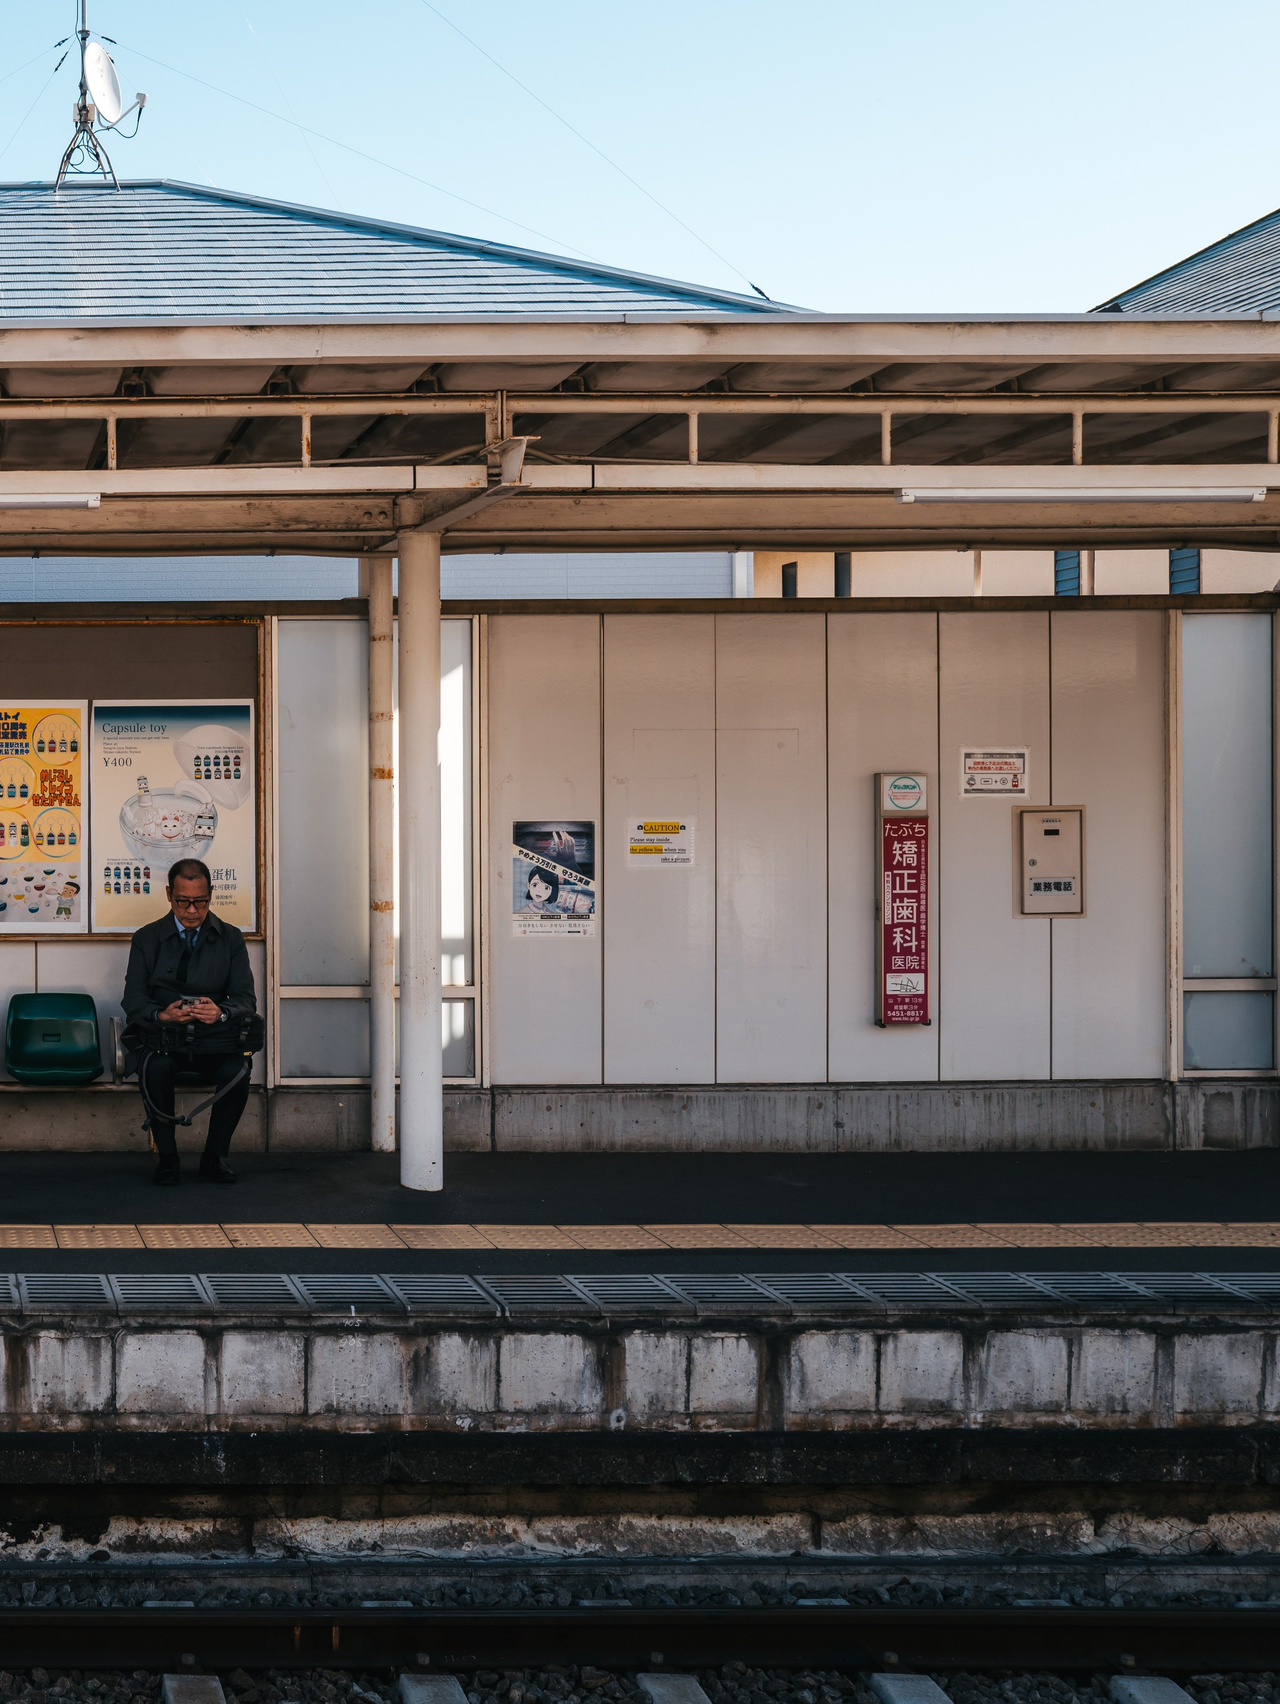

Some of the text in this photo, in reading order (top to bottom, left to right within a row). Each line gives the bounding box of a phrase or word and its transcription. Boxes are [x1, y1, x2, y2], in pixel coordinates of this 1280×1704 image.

[102, 723, 167, 735] Capsule toy
[40, 769, 73, 781] めじるし
[40, 781, 73, 794] トレイン
[32, 794, 81, 806] せたがやせん
[884, 823, 926, 837] たぶち
[210, 868, 237, 881] 蛋机
[518, 849, 591, 887] やめよう万引き 守ろう笑顔
[1033, 881, 1072, 892] 業務電話
[892, 840, 918, 953] 矯正歯科
[892, 955, 920, 970] 医院
